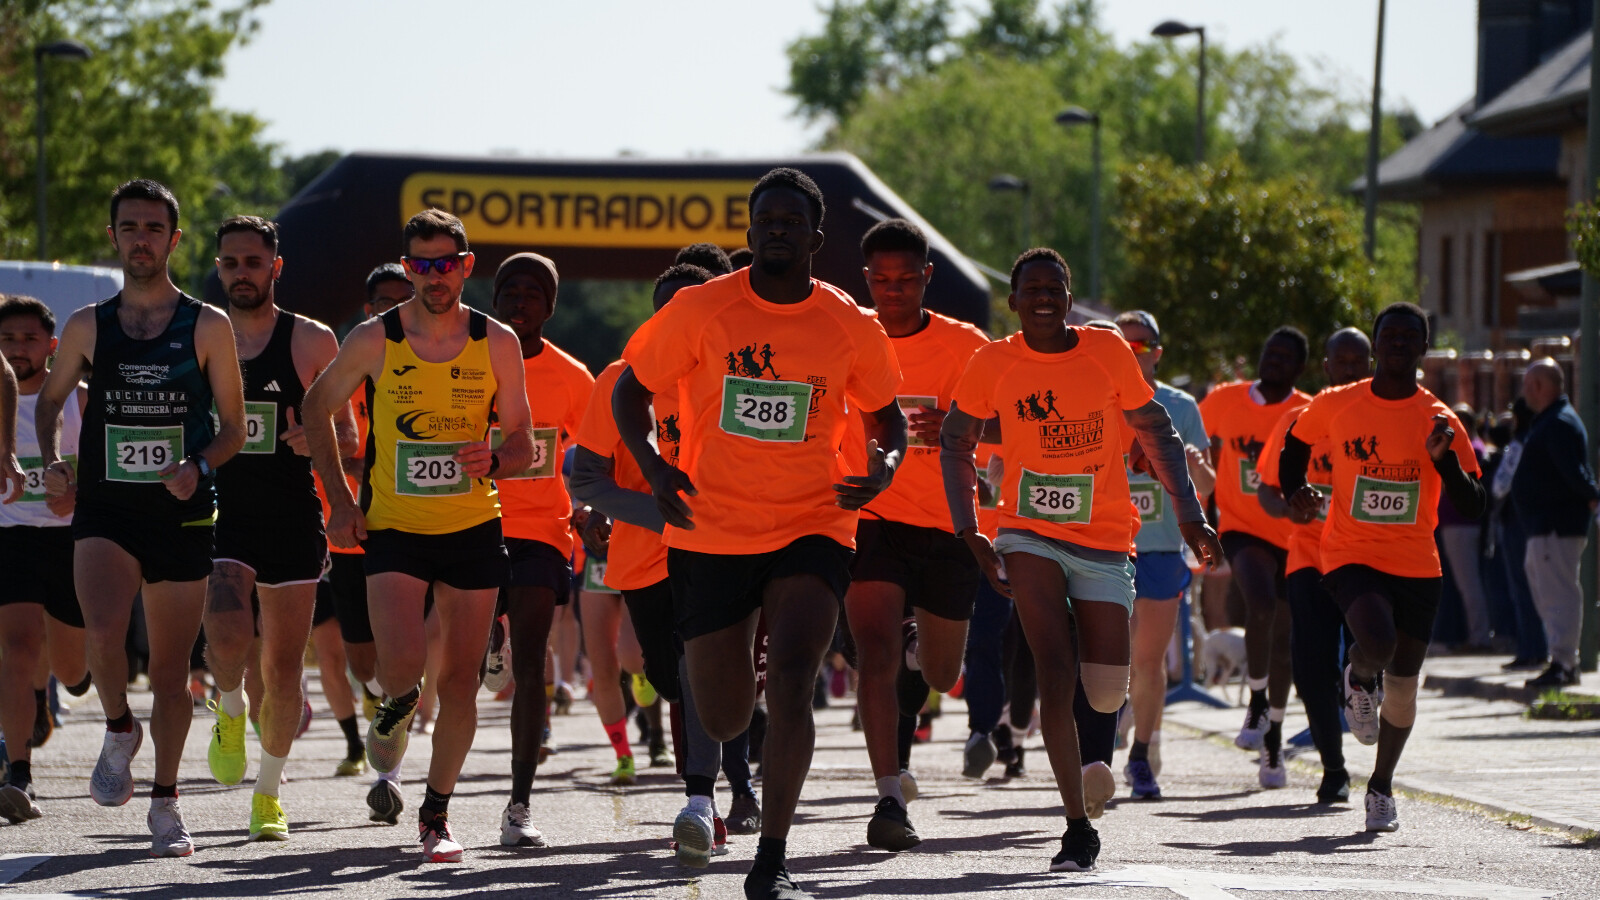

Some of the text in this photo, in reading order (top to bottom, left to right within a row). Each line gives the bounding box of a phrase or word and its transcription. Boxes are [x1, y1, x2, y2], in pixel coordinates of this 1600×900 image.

[105, 391, 186, 401] NOCTURNA
[121, 404, 188, 414] CONSUEGRA 2023
[741, 397, 788, 424] 288
[428, 415, 467, 424] CLÍNICA
[1049, 419, 1104, 436] CARRERA
[1041, 431, 1102, 448] INCLUSIVA
[123, 444, 166, 466] 219
[1042, 451, 1074, 459] FUNDACIÓN
[413, 460, 456, 480] 203
[1369, 467, 1420, 478] CARRERA
[1035, 487, 1075, 510] 286
[1368, 493, 1404, 511] 306
